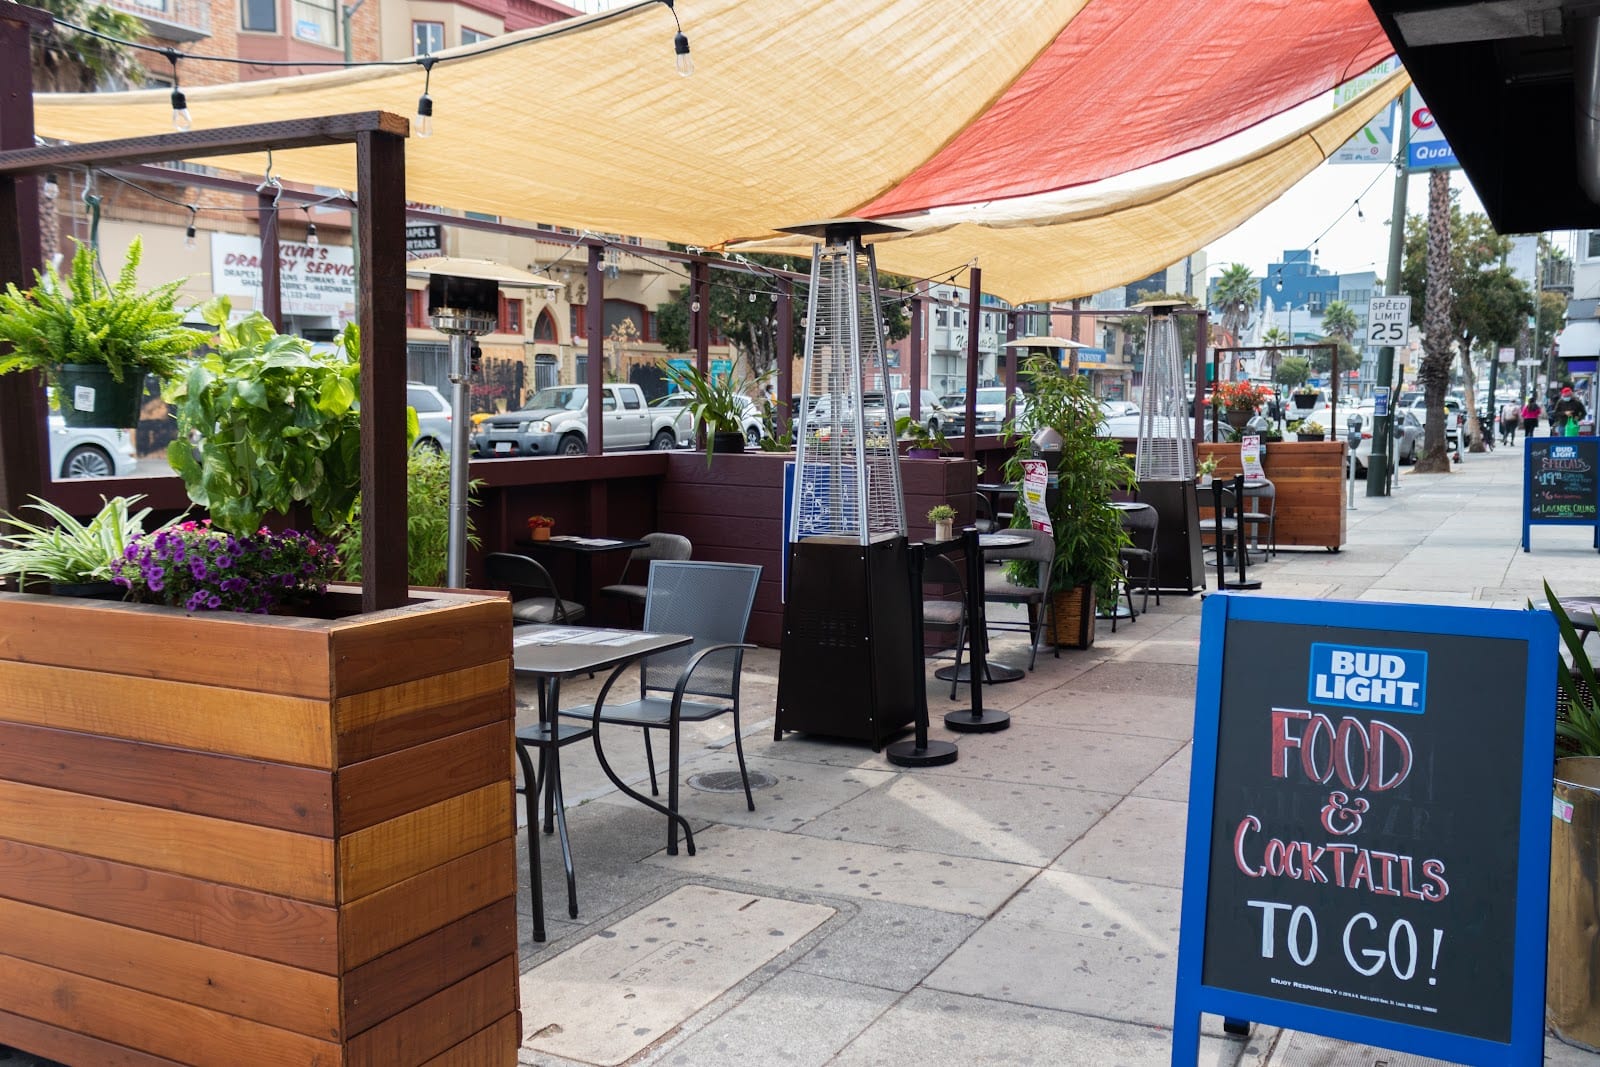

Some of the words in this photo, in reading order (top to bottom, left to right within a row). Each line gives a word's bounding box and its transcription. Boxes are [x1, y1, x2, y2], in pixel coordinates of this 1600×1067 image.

[1416, 146, 1455, 159] Qual
[279, 244, 329, 260] YLVIA'S
[406, 239, 437, 250] RTAINS
[305, 261, 355, 277] SERVIC
[1372, 302, 1407, 311] SPEED
[1375, 312, 1402, 321] LIMIT
[1371, 322, 1404, 340] 25
[1331, 650, 1406, 679] BUD
[1315, 673, 1419, 708] LIGHT
[1271, 707, 1413, 792] FOOD
[1320, 791, 1370, 835] &
[1233, 815, 1449, 902] COCKTAILS
[1247, 900, 1318, 966] TO
[1343, 912, 1444, 986] GO!
